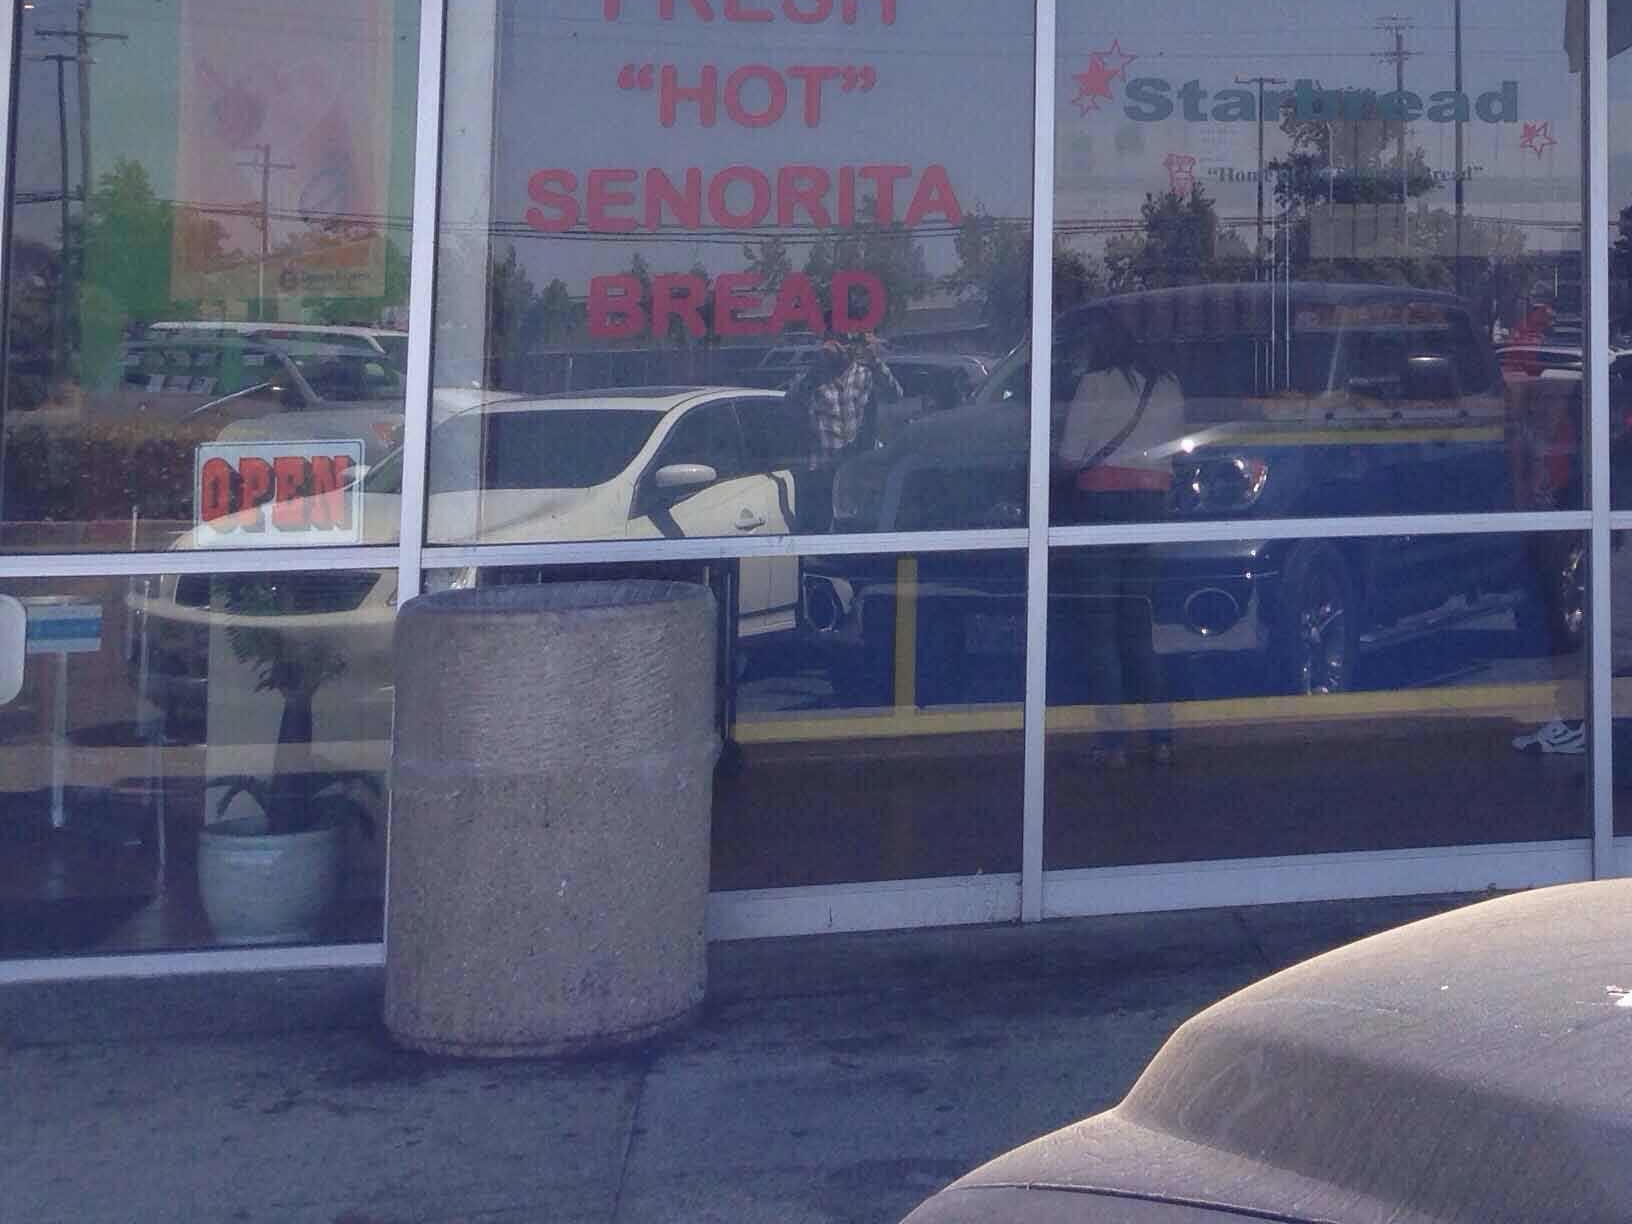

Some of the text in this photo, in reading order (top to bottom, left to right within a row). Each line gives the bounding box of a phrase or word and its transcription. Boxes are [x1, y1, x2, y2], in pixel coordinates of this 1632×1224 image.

[616, 63, 877, 129] "HOT"
[1123, 77, 1520, 123] Starbread
[526, 164, 963, 233] SENORITA
[586, 271, 888, 338] BREAD
[200, 454, 356, 533] OPEN
